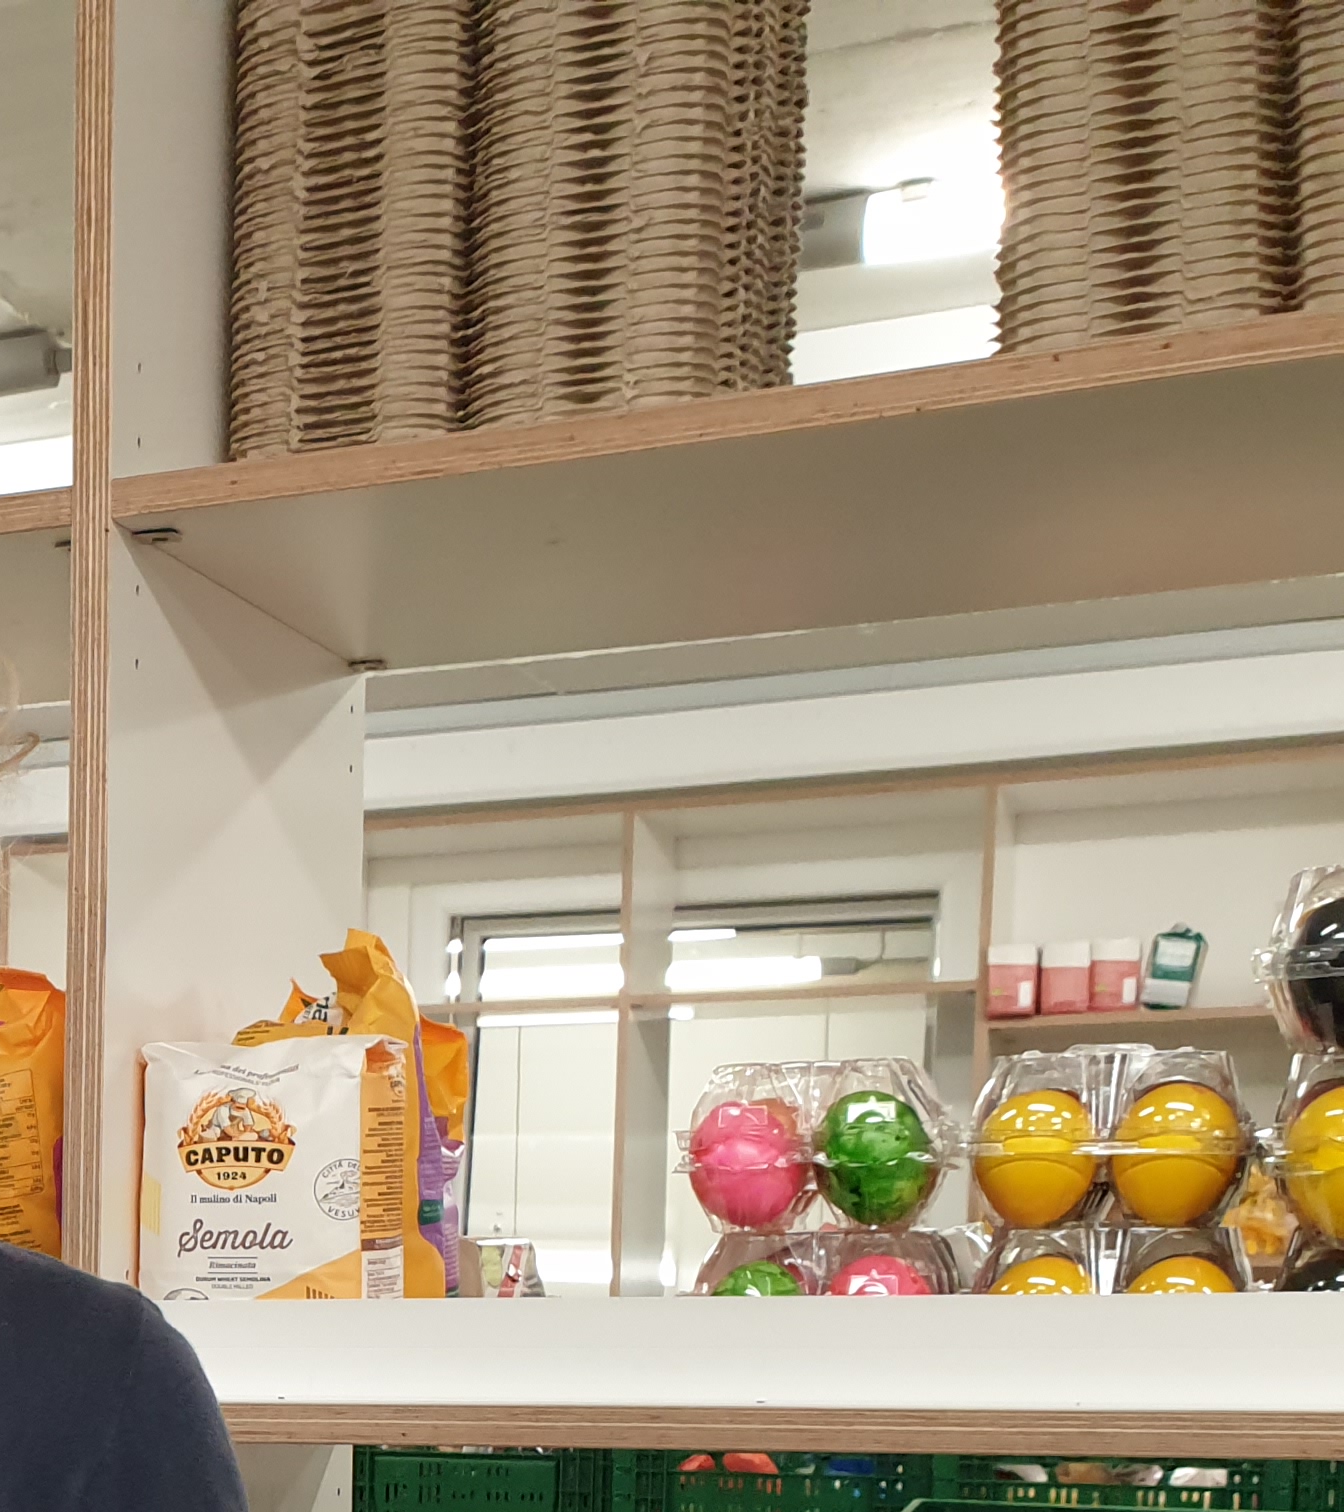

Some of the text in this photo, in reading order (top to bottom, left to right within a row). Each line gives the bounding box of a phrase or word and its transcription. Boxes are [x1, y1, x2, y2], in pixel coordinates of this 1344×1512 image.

[185, 1147, 285, 1167] CAPUTO
[216, 1171, 247, 1181] 1924
[190, 1193, 278, 1205] Il mulino di Napoli
[177, 1218, 294, 1258] Semola
